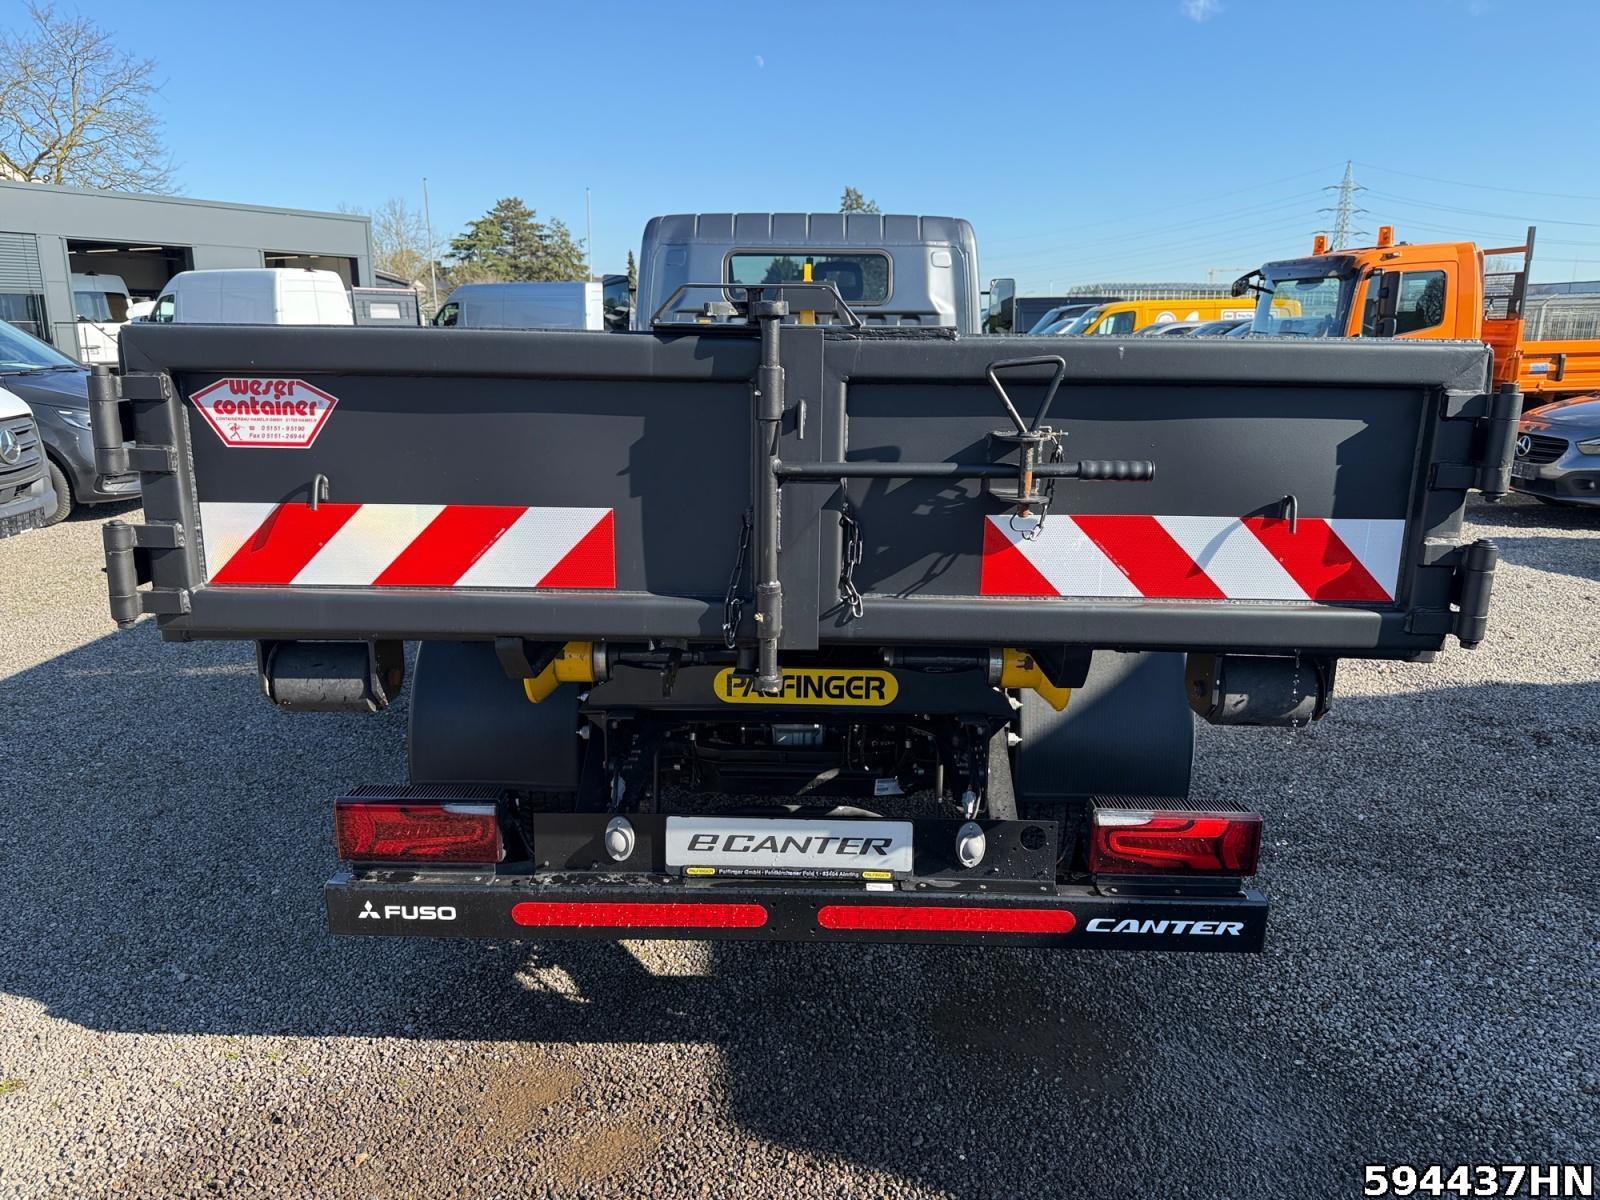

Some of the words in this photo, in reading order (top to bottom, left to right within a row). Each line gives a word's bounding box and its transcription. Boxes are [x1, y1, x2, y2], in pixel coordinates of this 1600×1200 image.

[229, 380, 295, 396] weser
[213, 394, 317, 416] container
[384, 905, 457, 920] FUSO
[1085, 918, 1244, 936] CANTER
